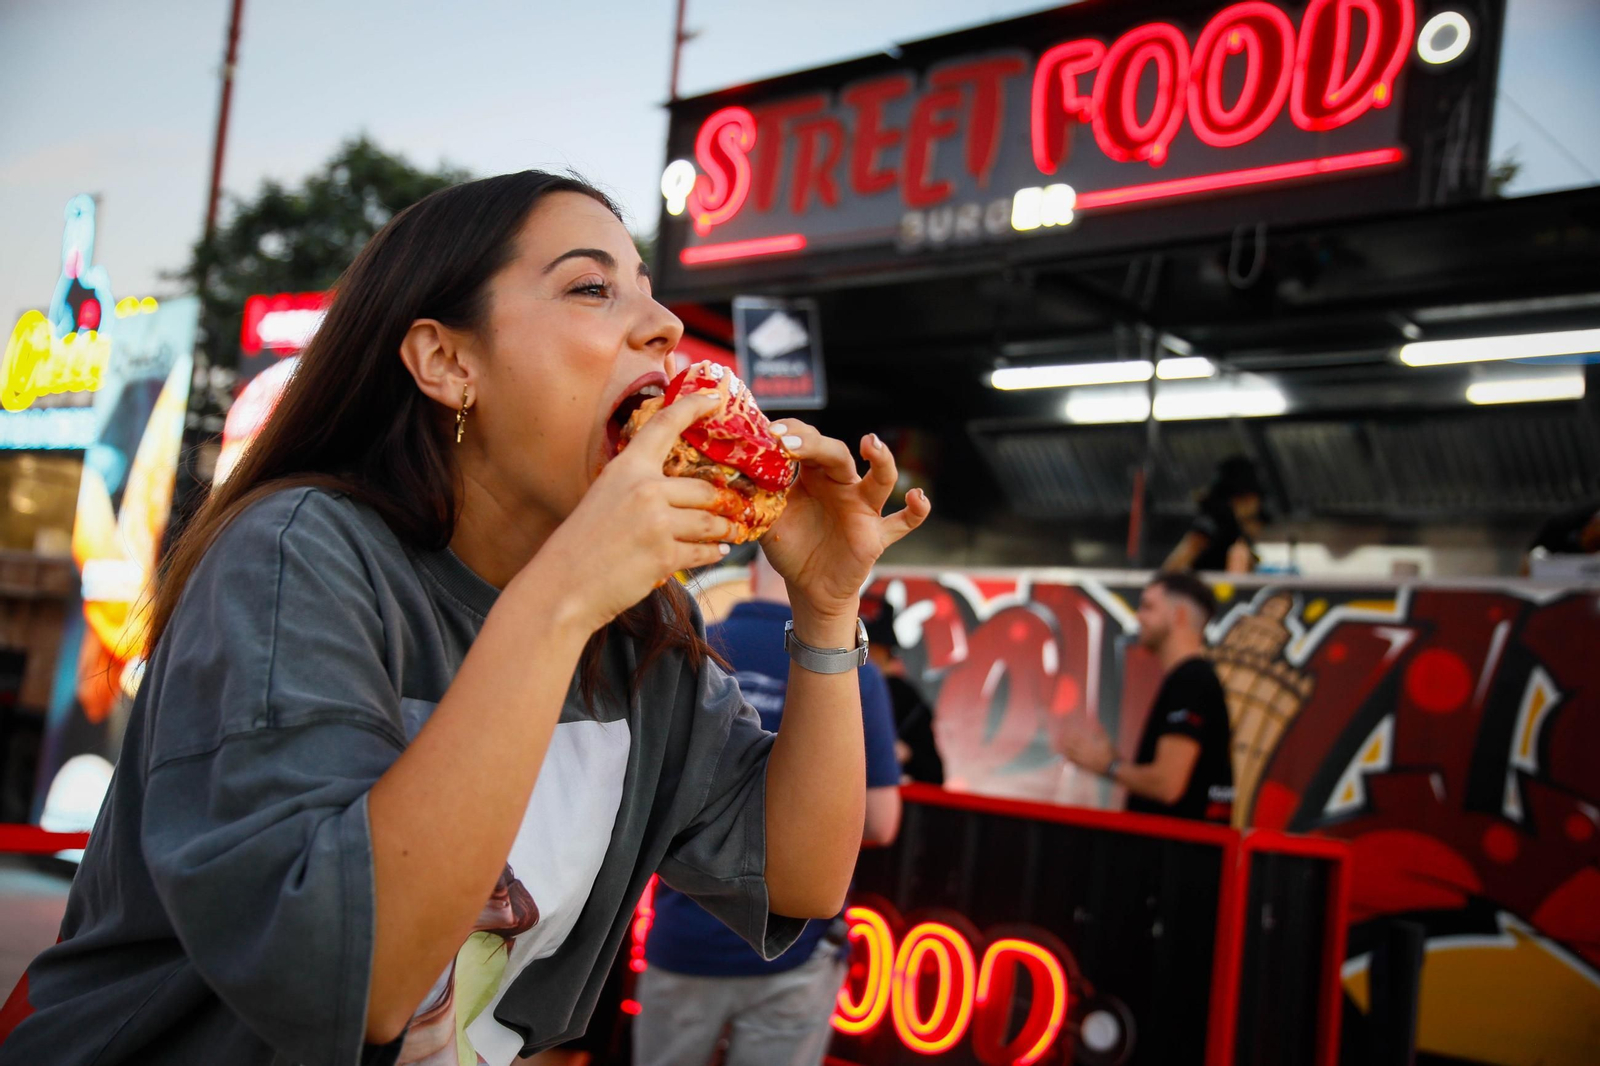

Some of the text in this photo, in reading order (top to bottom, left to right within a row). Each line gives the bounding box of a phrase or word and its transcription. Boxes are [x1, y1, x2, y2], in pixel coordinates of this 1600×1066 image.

[687, 0, 1415, 236] STREET FOOD
[830, 906, 1068, 1066] OOD
